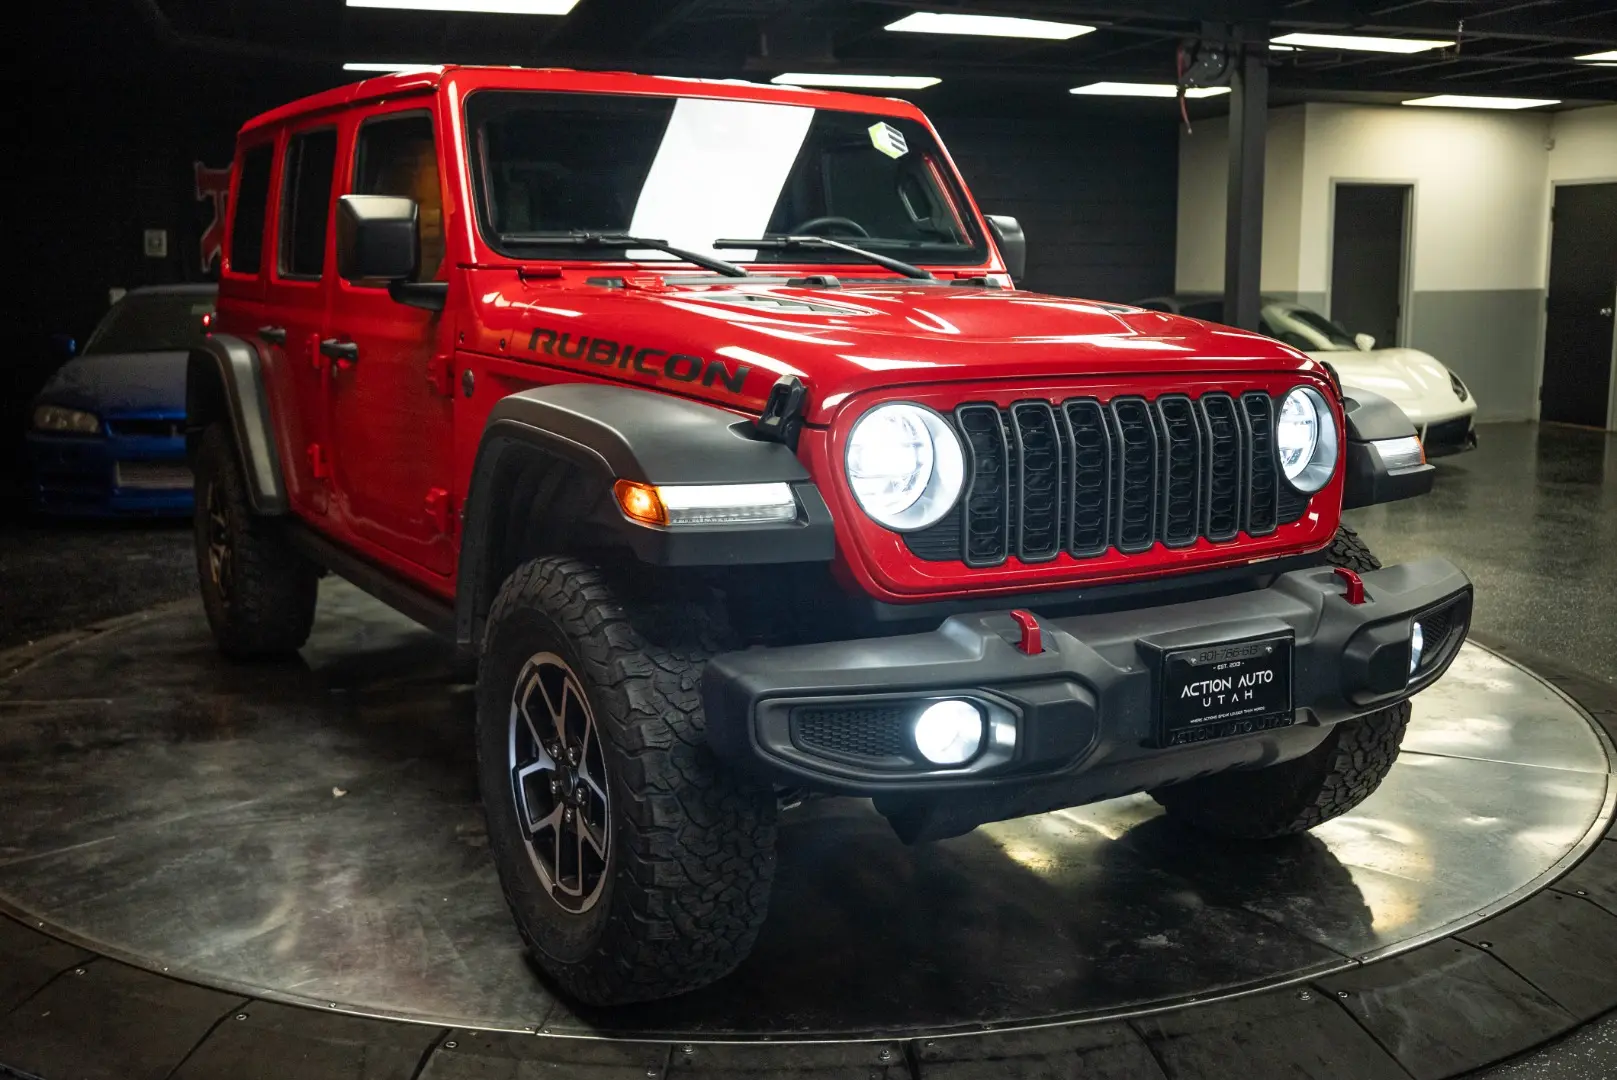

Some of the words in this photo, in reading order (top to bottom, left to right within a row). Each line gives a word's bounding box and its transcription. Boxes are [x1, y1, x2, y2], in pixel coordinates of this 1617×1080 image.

[527, 327, 750, 394] RUBICON
[1181, 676, 1232, 698] ACTION
[1238, 669, 1273, 688] AUTO
[1203, 690, 1253, 707] UTAH
[1169, 726, 1215, 745] ACTION
[1220, 720, 1253, 736] AUTO
